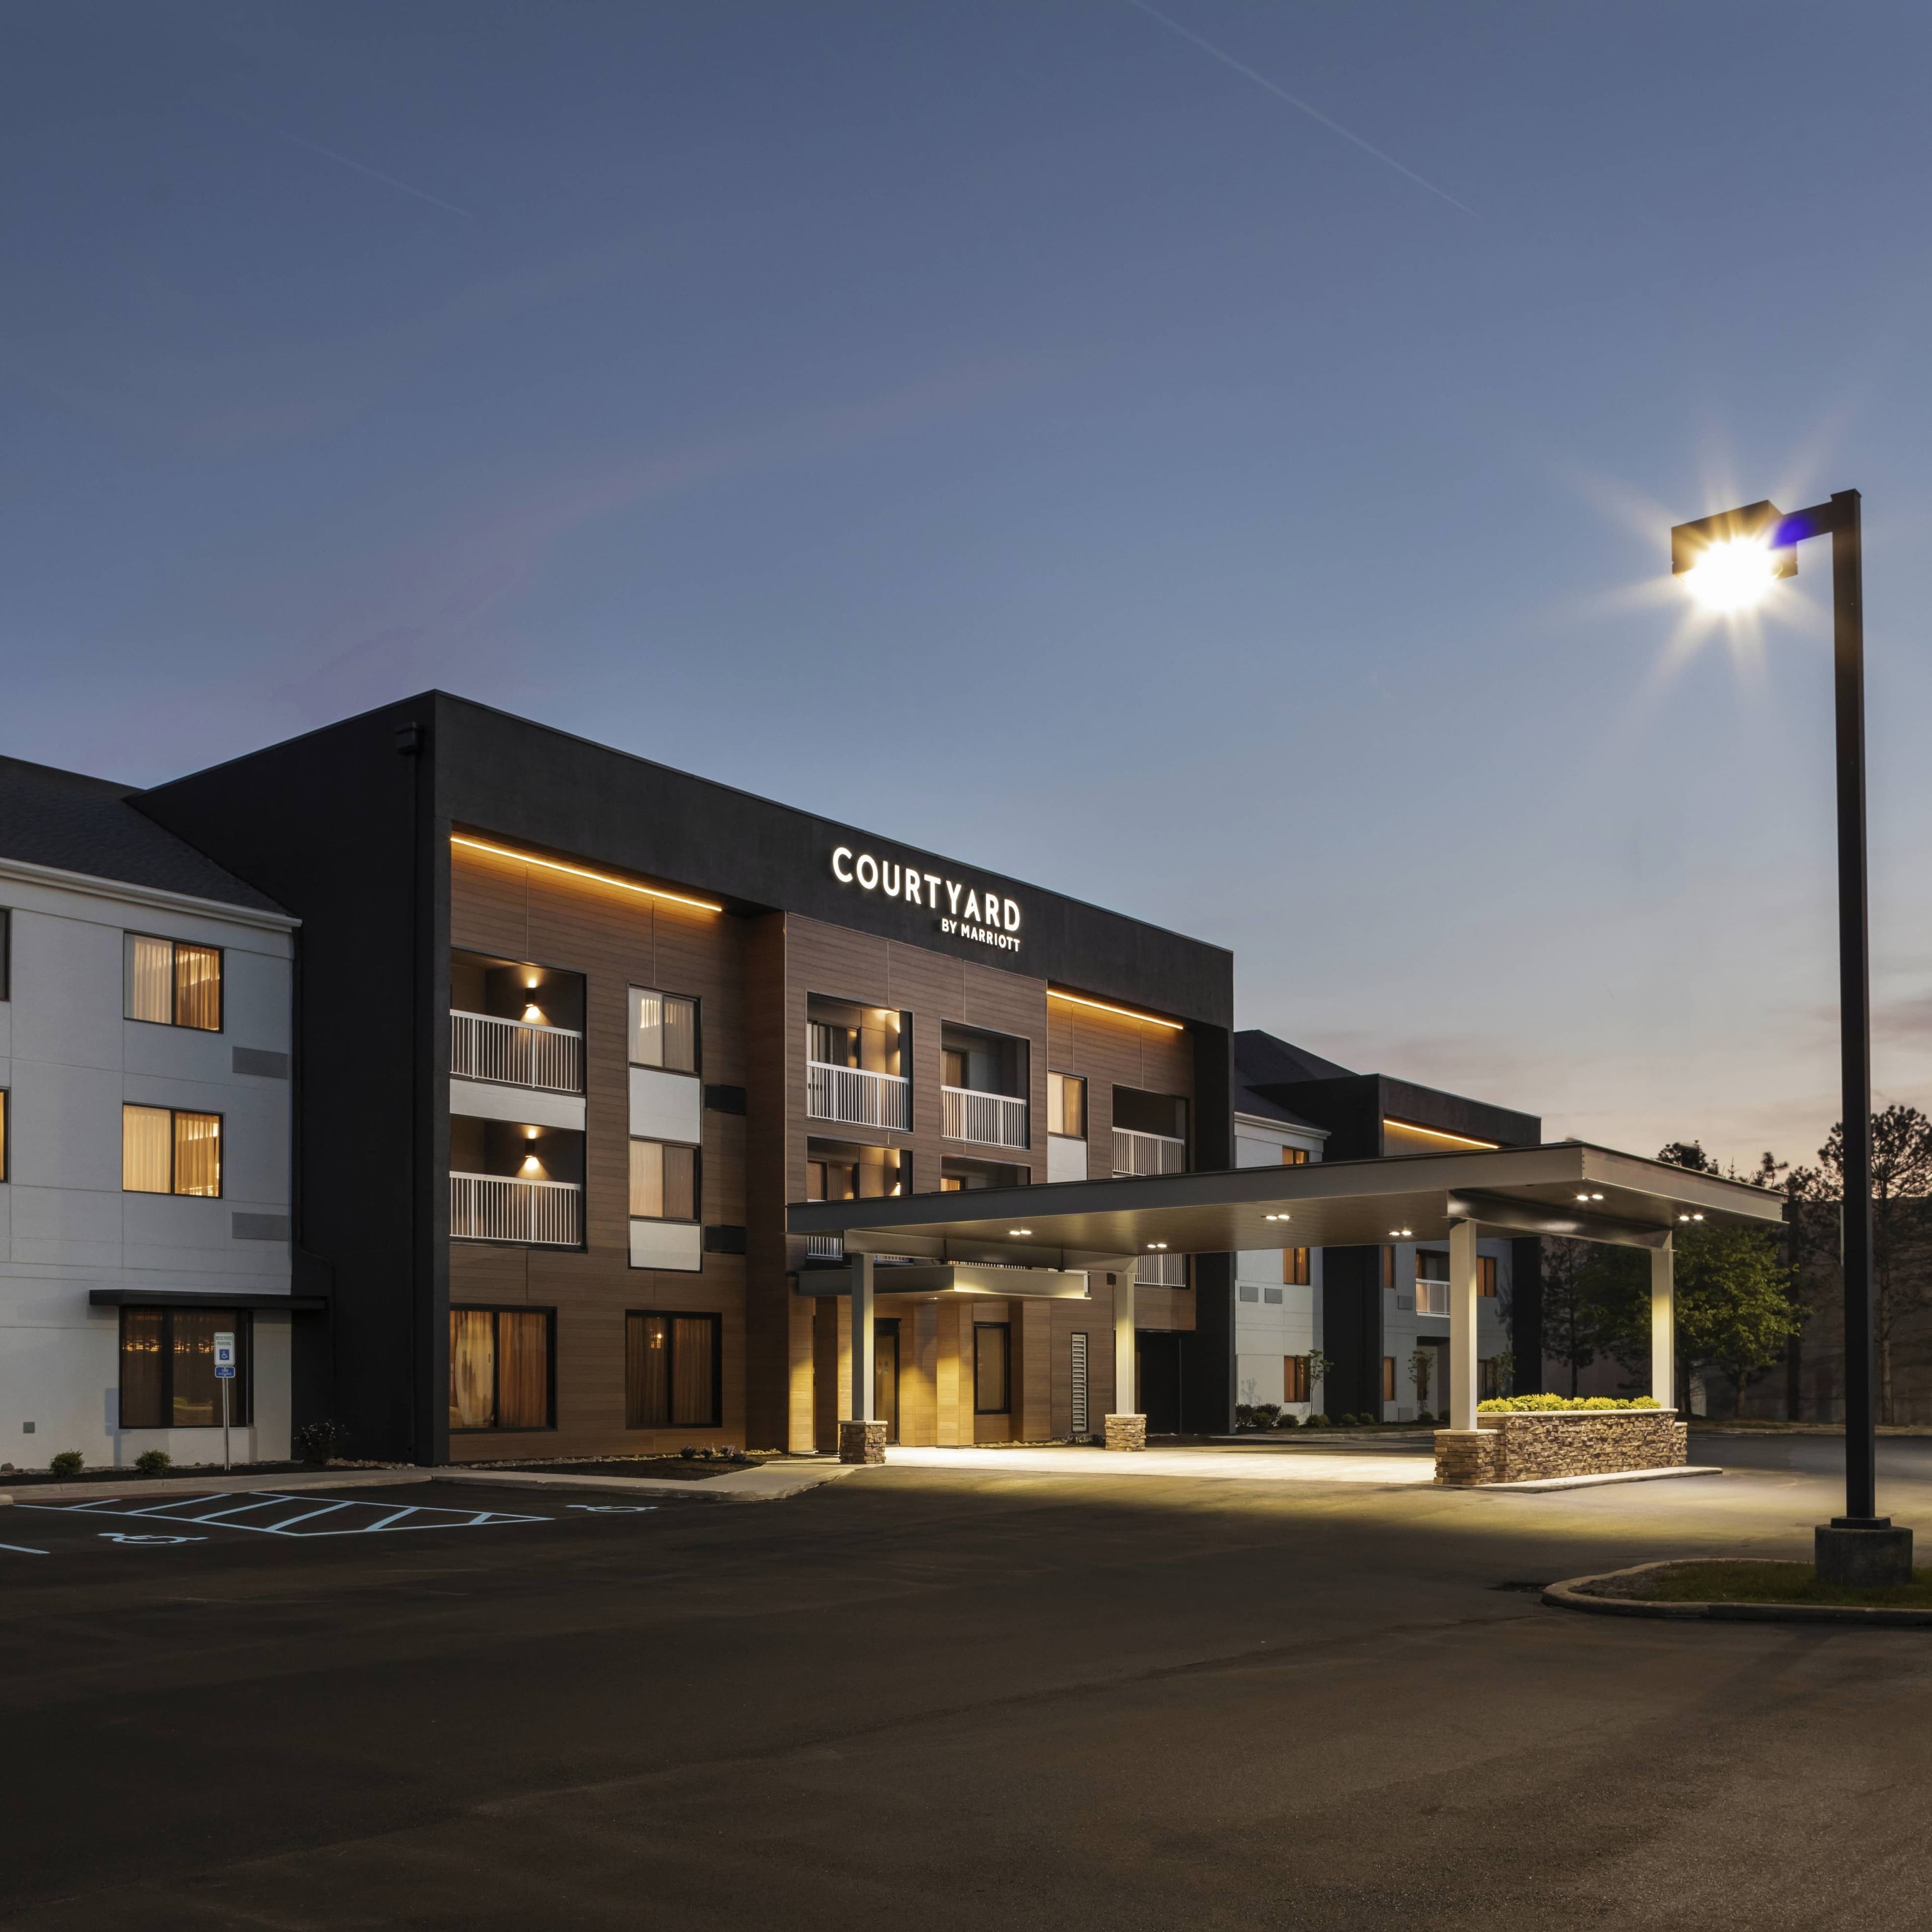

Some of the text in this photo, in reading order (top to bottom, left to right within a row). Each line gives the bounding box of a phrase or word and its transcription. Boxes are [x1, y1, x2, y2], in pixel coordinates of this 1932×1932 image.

[833, 847, 1020, 931] COURTYARD
[942, 918, 1020, 952] BY MARRIOTT
